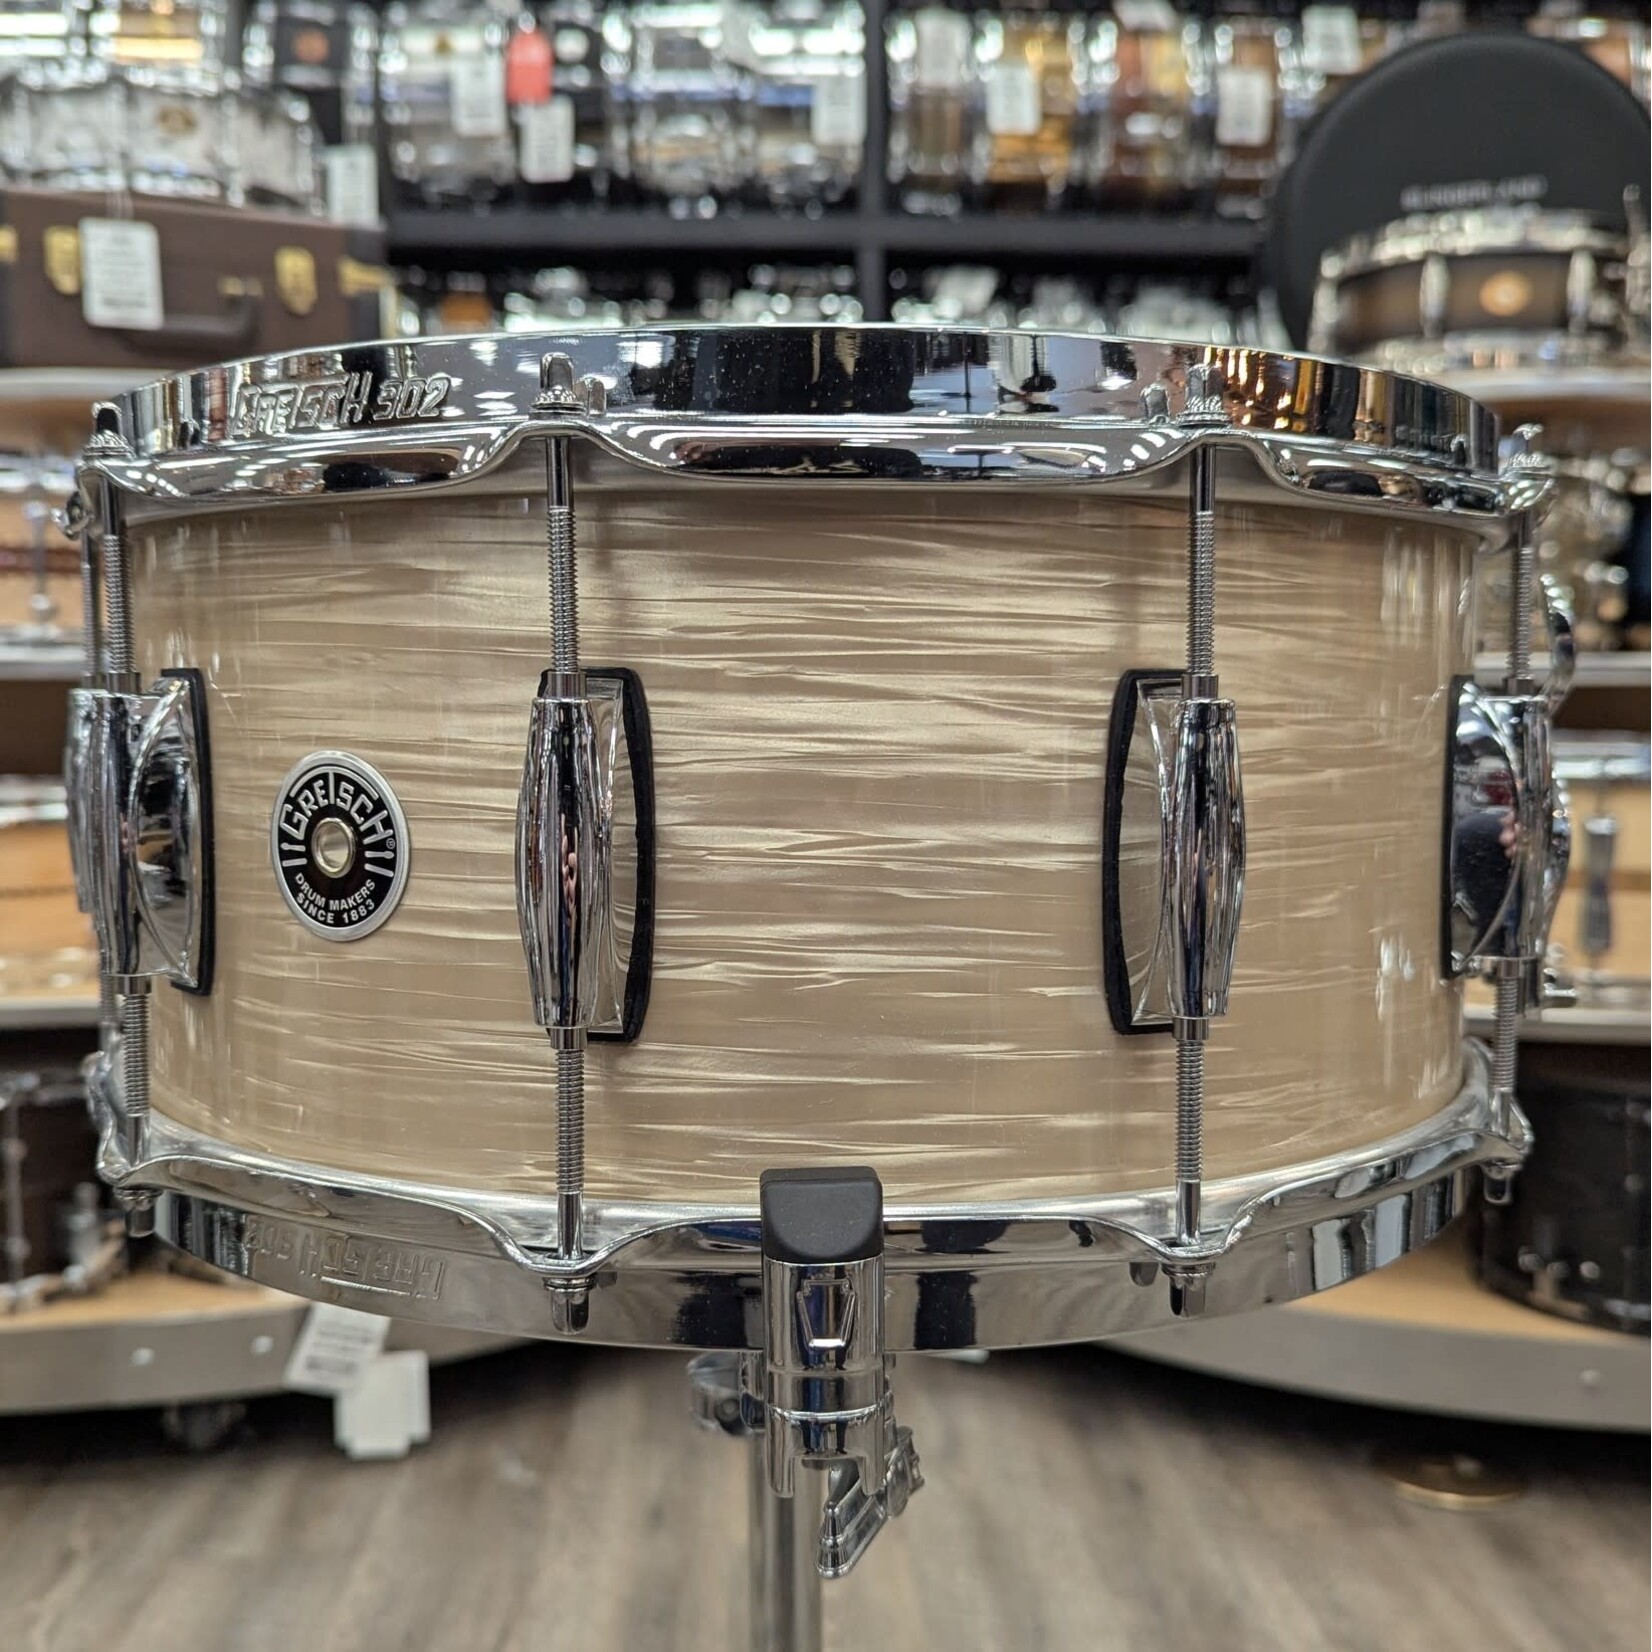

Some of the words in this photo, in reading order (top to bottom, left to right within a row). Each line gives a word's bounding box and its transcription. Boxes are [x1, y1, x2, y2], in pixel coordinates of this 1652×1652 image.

[227, 371, 373, 438] GRETSCH
[373, 375, 449, 421] 302
[295, 873, 326, 907] DRUM
[329, 879, 376, 911] MAKERS
[296, 892, 335, 924] SINCE
[342, 899, 375, 924] 1883
